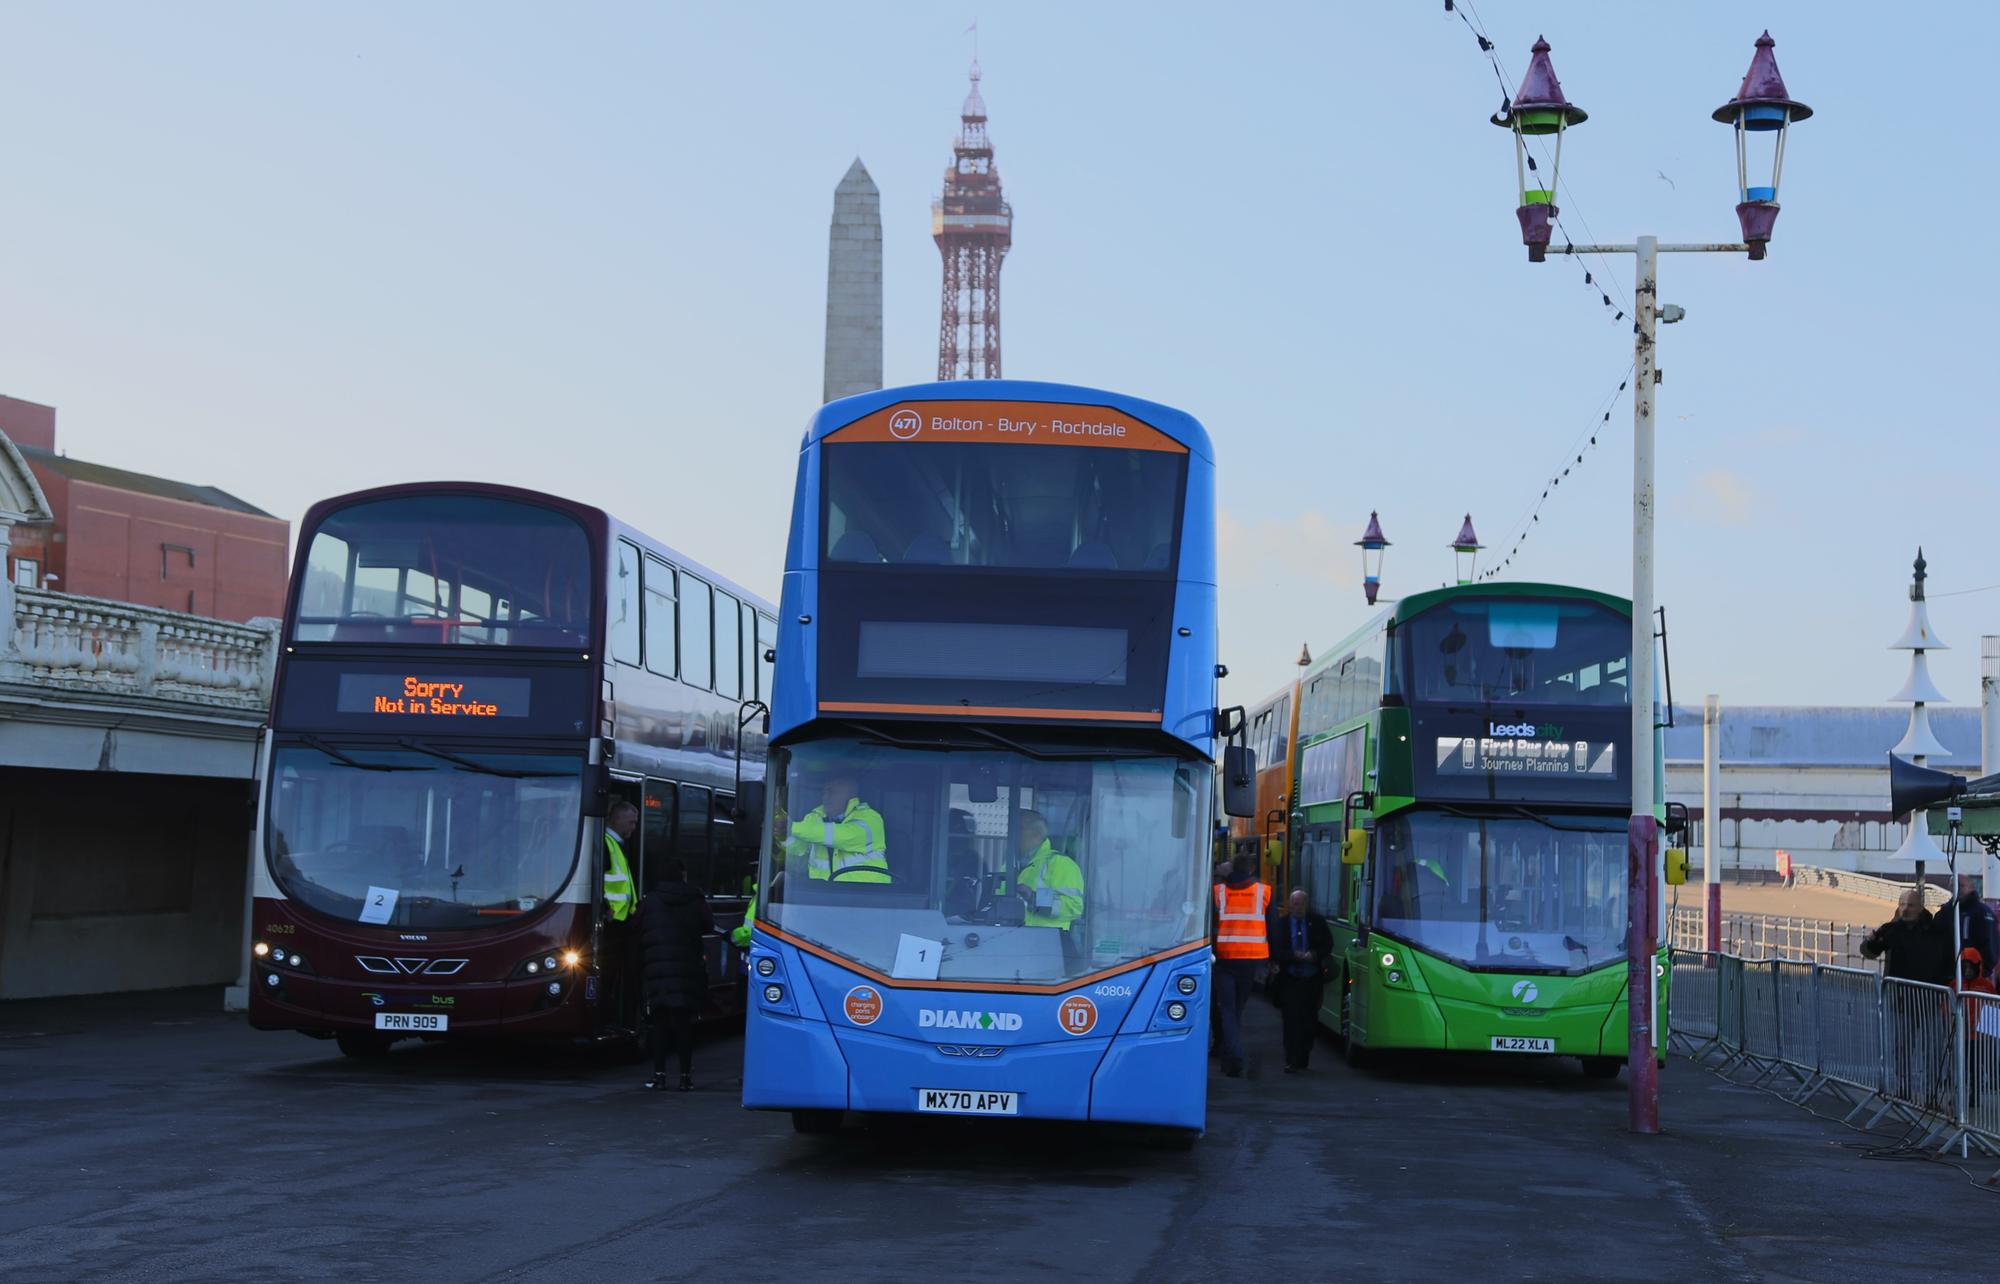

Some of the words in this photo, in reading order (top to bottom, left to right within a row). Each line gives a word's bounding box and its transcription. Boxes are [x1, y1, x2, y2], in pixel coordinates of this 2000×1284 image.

[894, 417, 918, 430] 471
[931, 417, 984, 431] Bolton
[998, 418, 1037, 436] Bury
[1052, 420, 1127, 437] Rochdale
[403, 676, 464, 698] Sorry
[374, 696, 405, 714] Not
[409, 699, 426, 714] in
[429, 698, 498, 716] Service
[1489, 722, 1536, 737] Leeds
[1536, 724, 1565, 741] city
[1480, 738, 1514, 757] First
[1516, 739, 1542, 758] Bus
[1481, 757, 1524, 772] Journey
[1526, 758, 1569, 773] Planning
[374, 894, 385, 906] 2
[918, 949, 926, 963] 1
[1094, 985, 1132, 997] 40804
[432, 995, 455, 1004] bus
[384, 1015, 410, 1028] PRN
[412, 1016, 438, 1029] 909
[1068, 1008, 1088, 1027] 10
[1496, 1038, 1525, 1049] ML22
[1528, 1039, 1549, 1051] XLA
[926, 1091, 972, 1110] MX70
[976, 1093, 1010, 1111] APV
